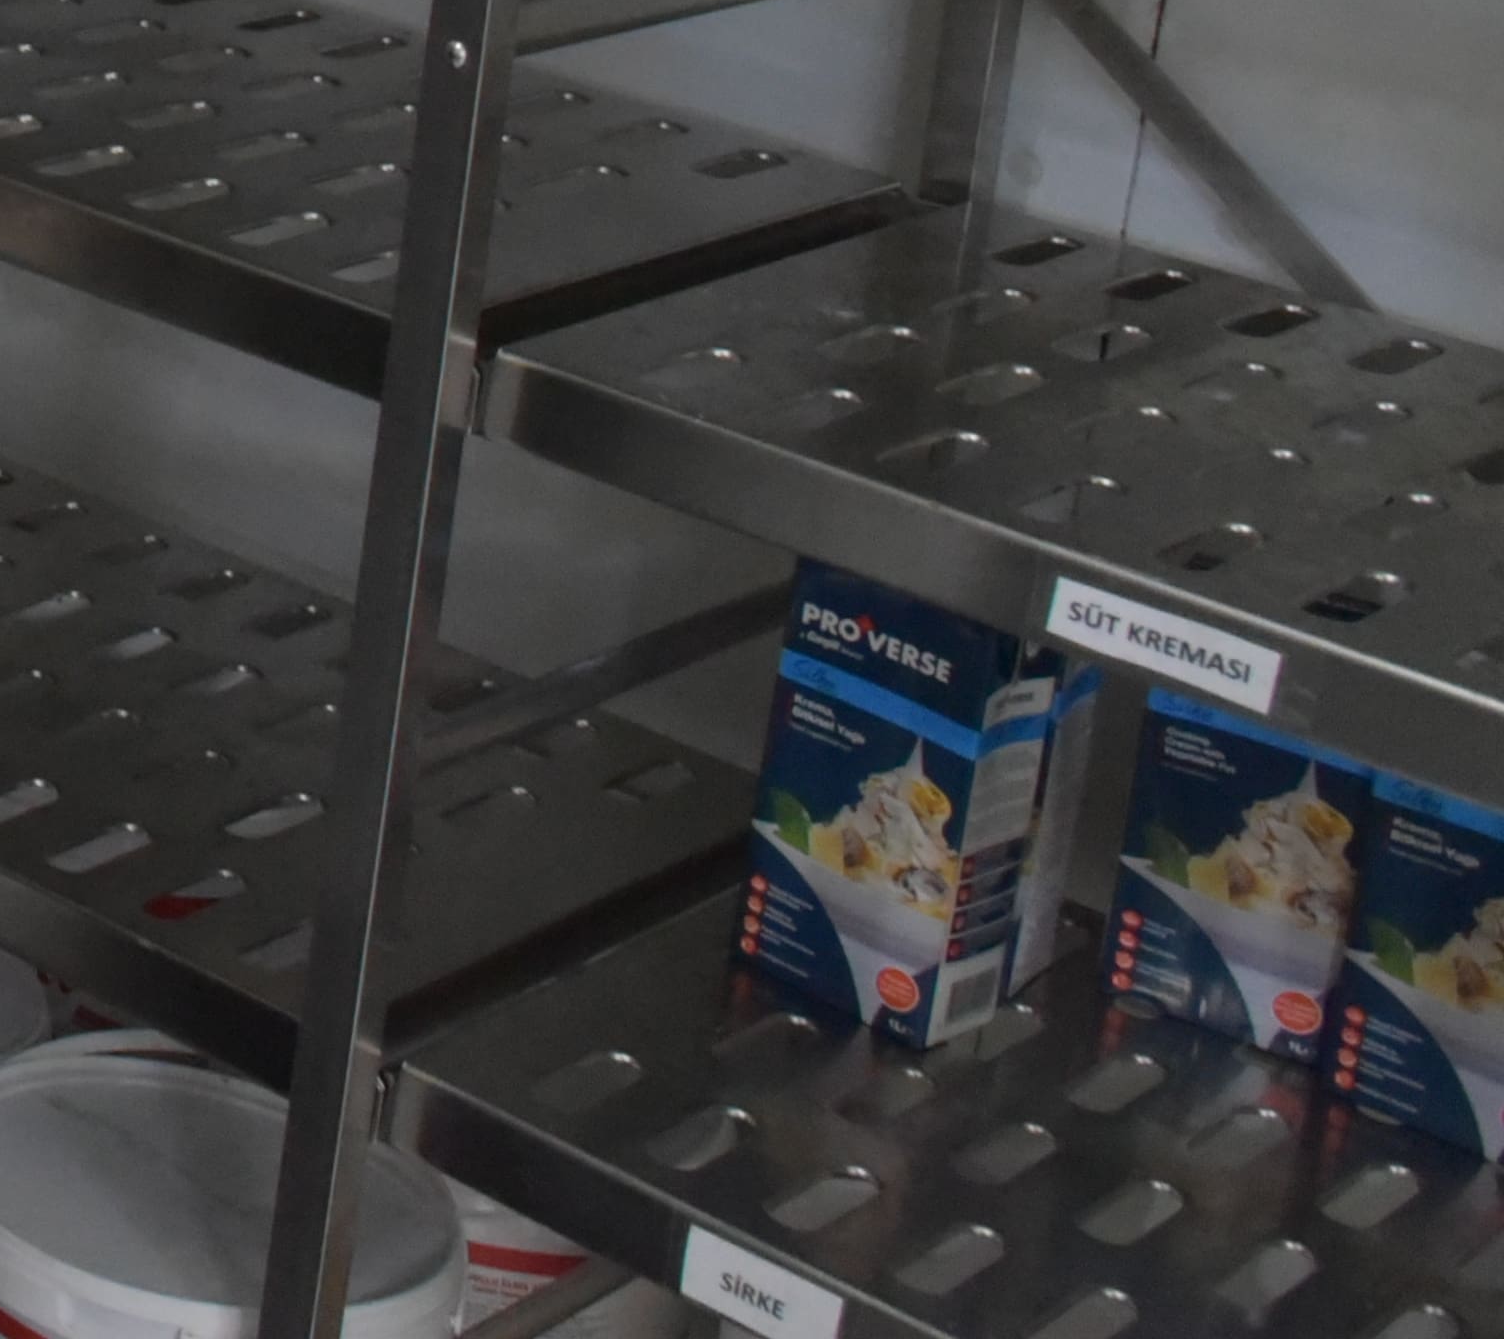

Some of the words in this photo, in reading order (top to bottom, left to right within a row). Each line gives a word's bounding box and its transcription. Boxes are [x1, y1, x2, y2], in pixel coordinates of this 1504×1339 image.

[801, 602, 861, 642] PRO
[866, 630, 953, 684] VERSE
[1067, 601, 1121, 636] SÜT
[1125, 622, 1251, 684] KREMASI
[719, 1272, 785, 1321] SİRKE
